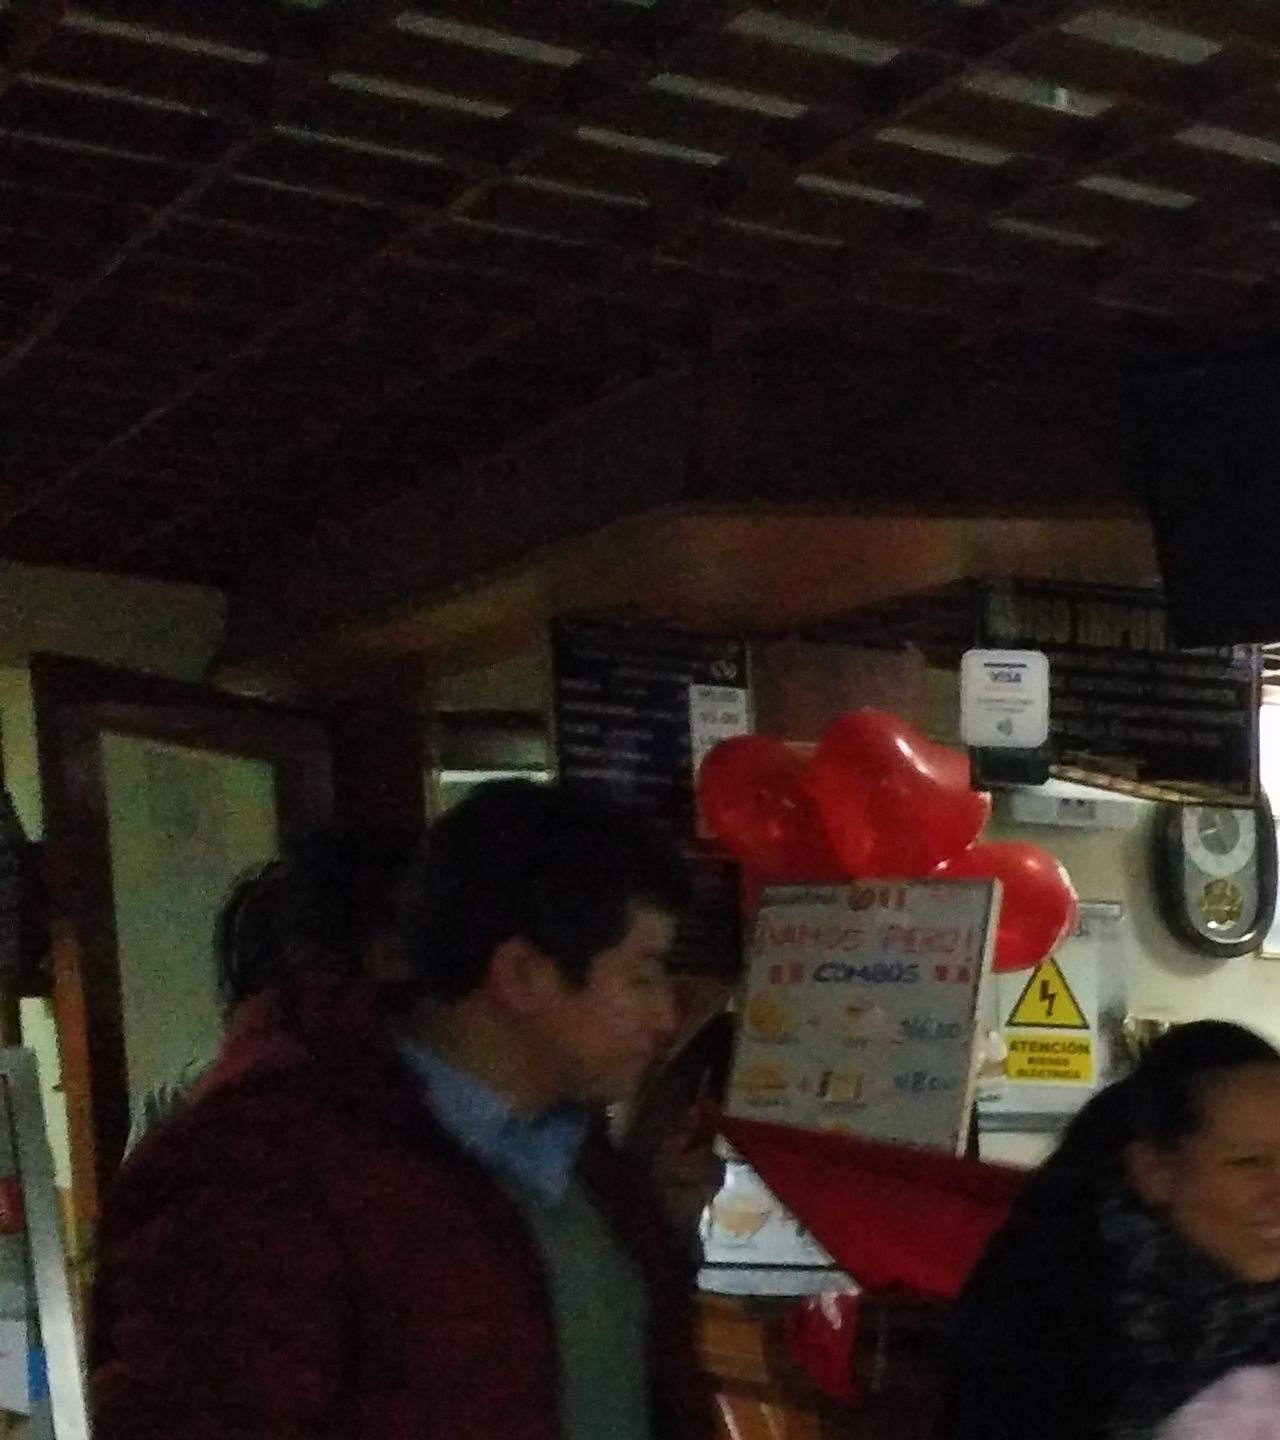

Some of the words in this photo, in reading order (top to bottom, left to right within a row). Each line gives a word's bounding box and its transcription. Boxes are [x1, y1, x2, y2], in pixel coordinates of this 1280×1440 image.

[1077, 602, 1168, 651] IMPOR
[989, 671, 1022, 683] VISA
[813, 962, 919, 983] COMBOS
